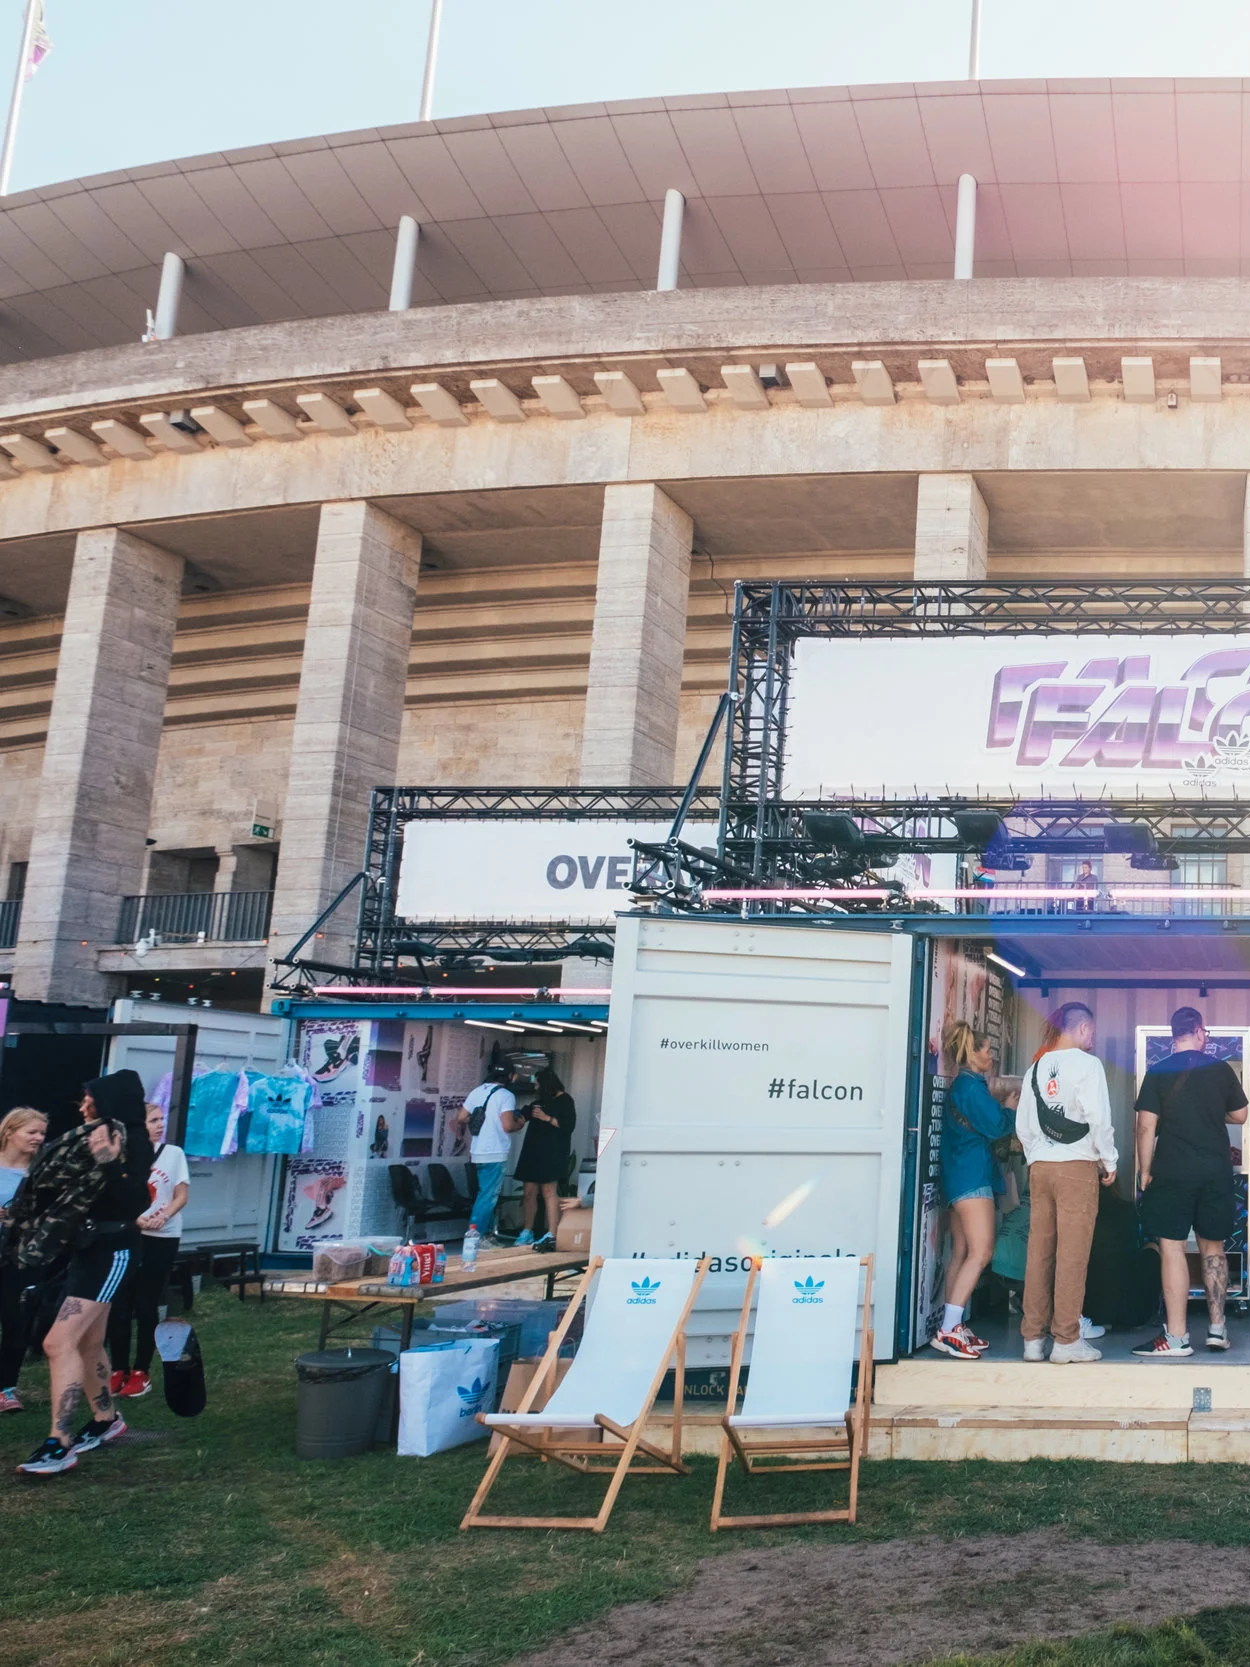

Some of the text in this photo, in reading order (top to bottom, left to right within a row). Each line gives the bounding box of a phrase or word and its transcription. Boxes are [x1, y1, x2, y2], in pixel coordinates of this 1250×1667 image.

[1214, 756, 1249, 766] adidas
[1183, 778, 1217, 788] adidas
[660, 1038, 770, 1052] #overkillwomen
[768, 1077, 864, 1101] #falcon
[626, 1296, 657, 1305] adidas
[792, 1296, 824, 1304] adidas
[684, 1384, 724, 1396] NLOCK
